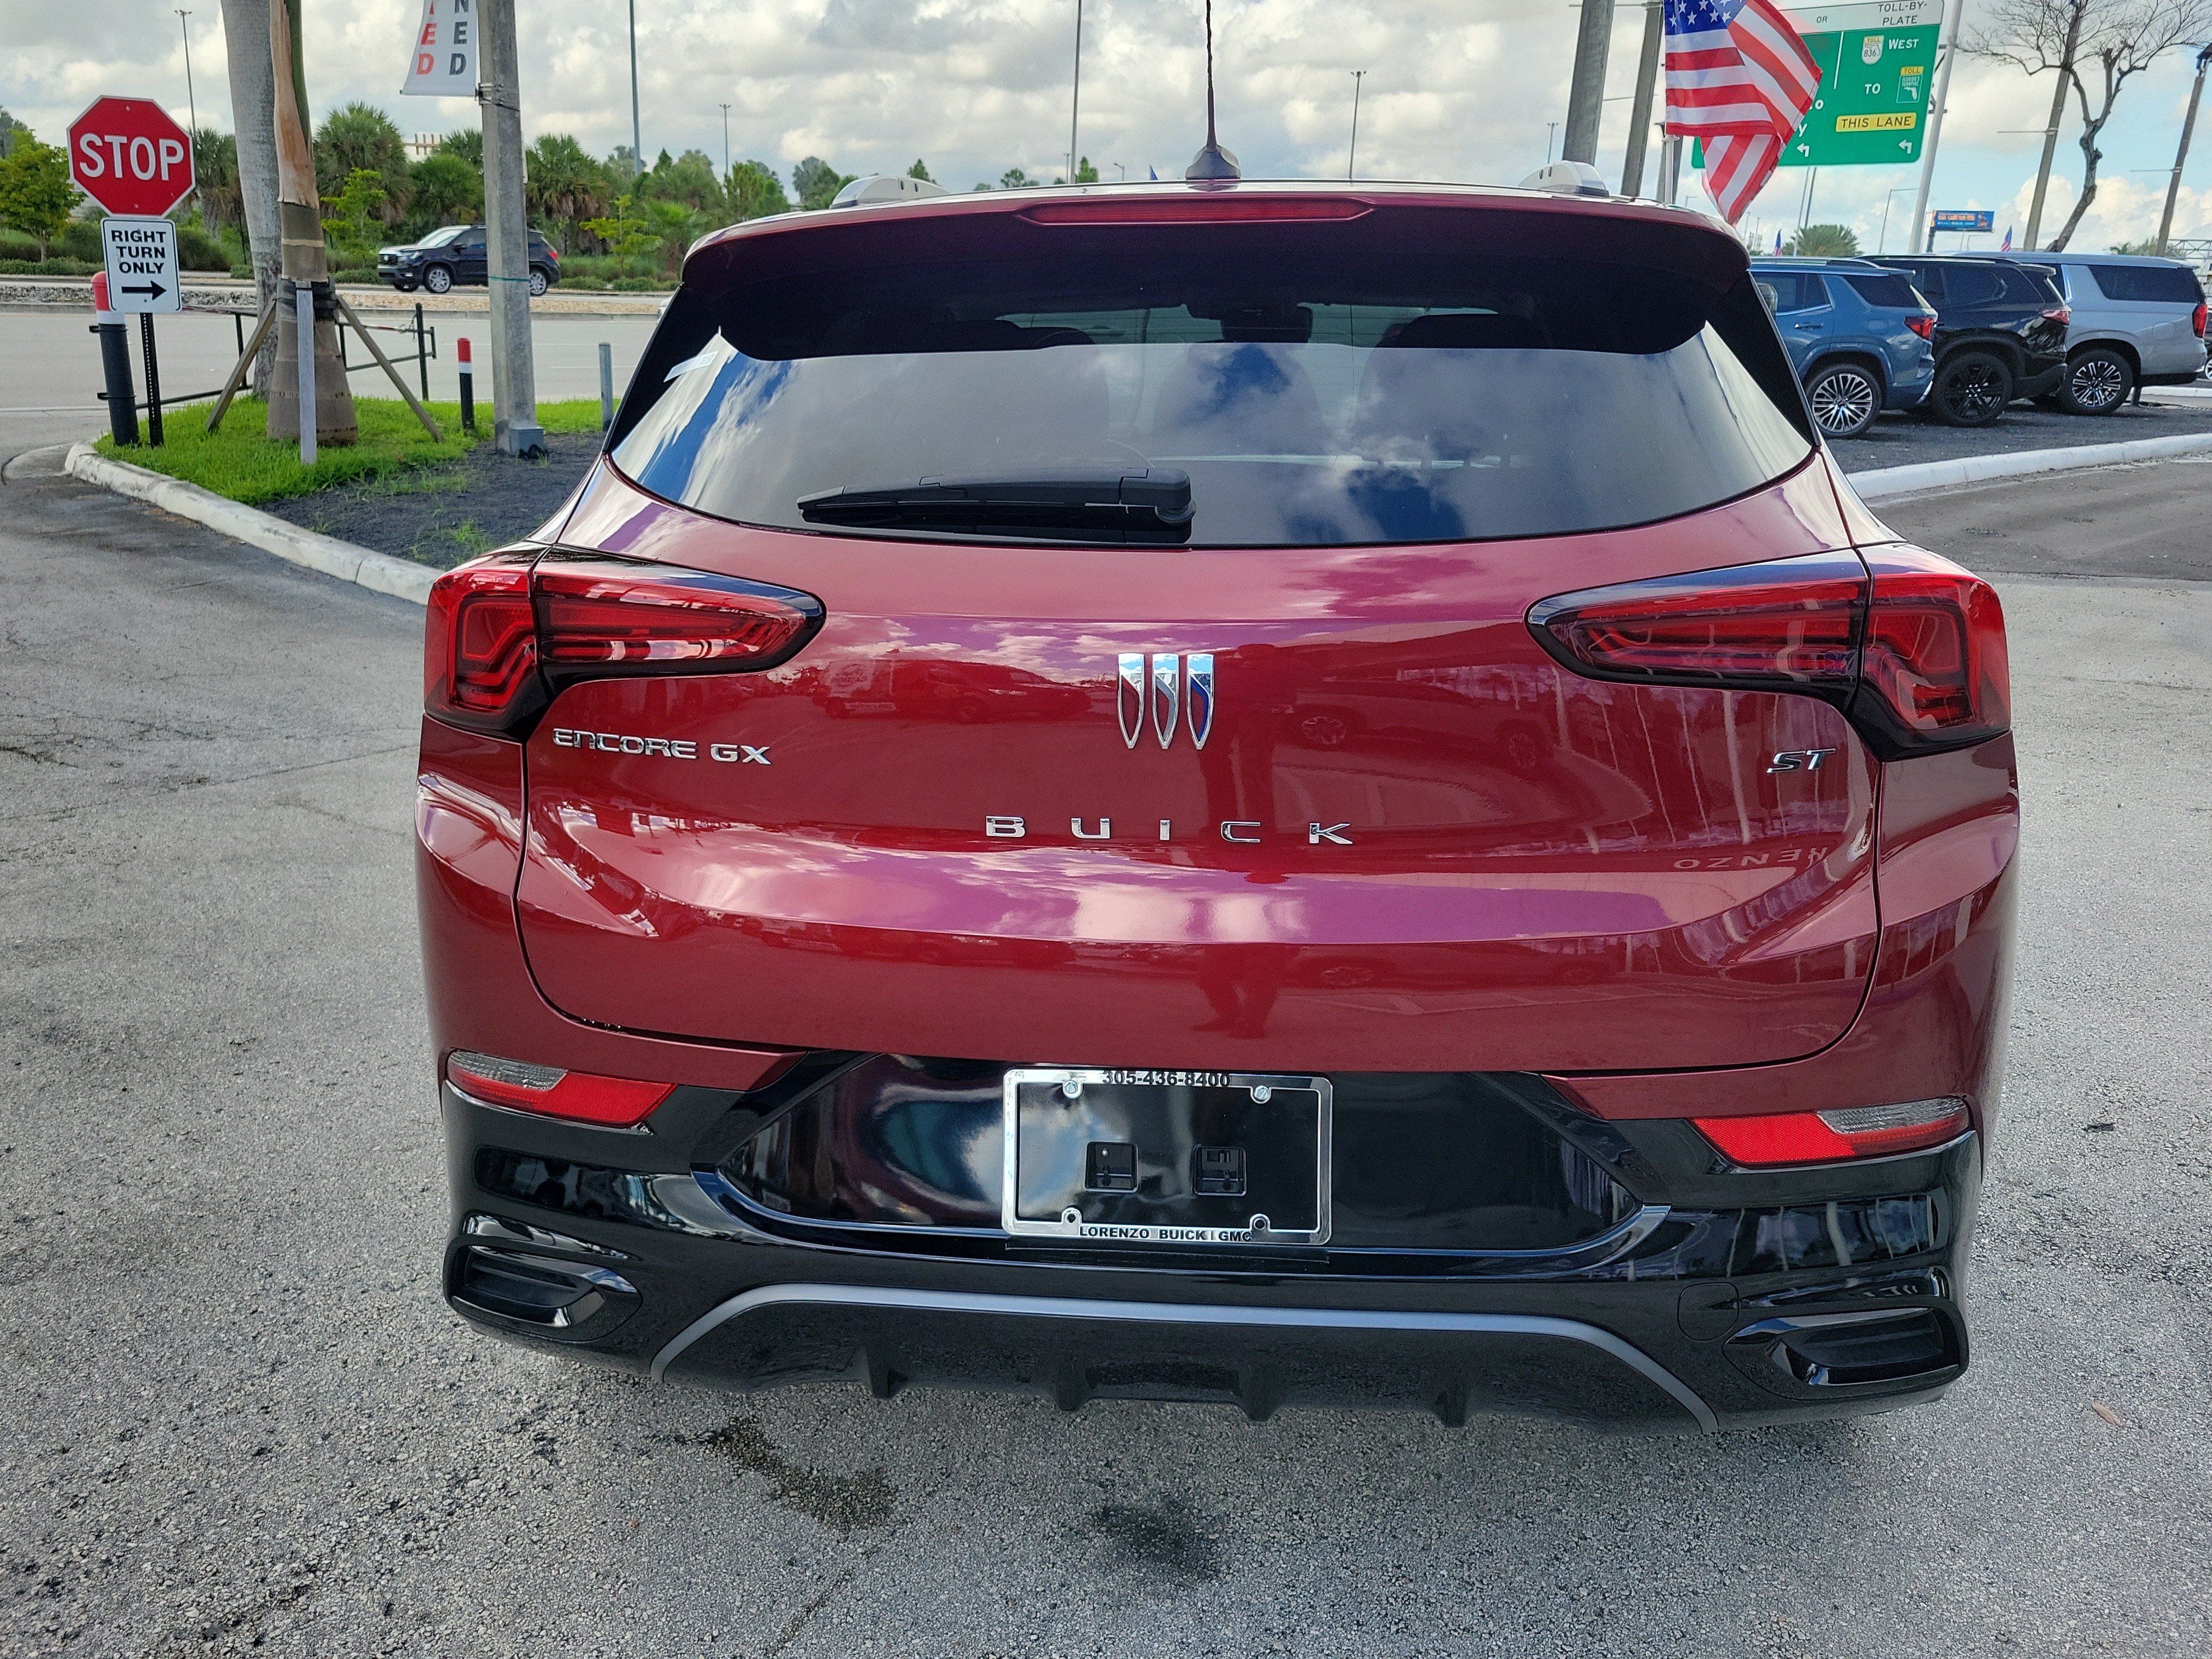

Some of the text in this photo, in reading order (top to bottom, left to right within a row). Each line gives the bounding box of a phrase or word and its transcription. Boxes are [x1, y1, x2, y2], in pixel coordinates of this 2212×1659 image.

[1878, 1, 1927, 13] TOLL-BY-
[1882, 15, 1917, 26] PLATE
[1888, 38, 1919, 49] WEST
[1865, 83, 1881, 94] TO
[1842, 116, 1912, 128] THIS LANE
[80, 133, 184, 181] STOP
[111, 230, 166, 243] RIGHT
[116, 246, 165, 258] TURN
[119, 262, 164, 274] ONLY
[552, 727, 771, 765] ENCORE GX
[1766, 748, 1836, 774] ST
[986, 815, 1353, 845] BUICK
[1102, 1070, 1231, 1087] 305-436-8400
[1080, 1226, 1252, 1242] LORENZO BUICK GMC
